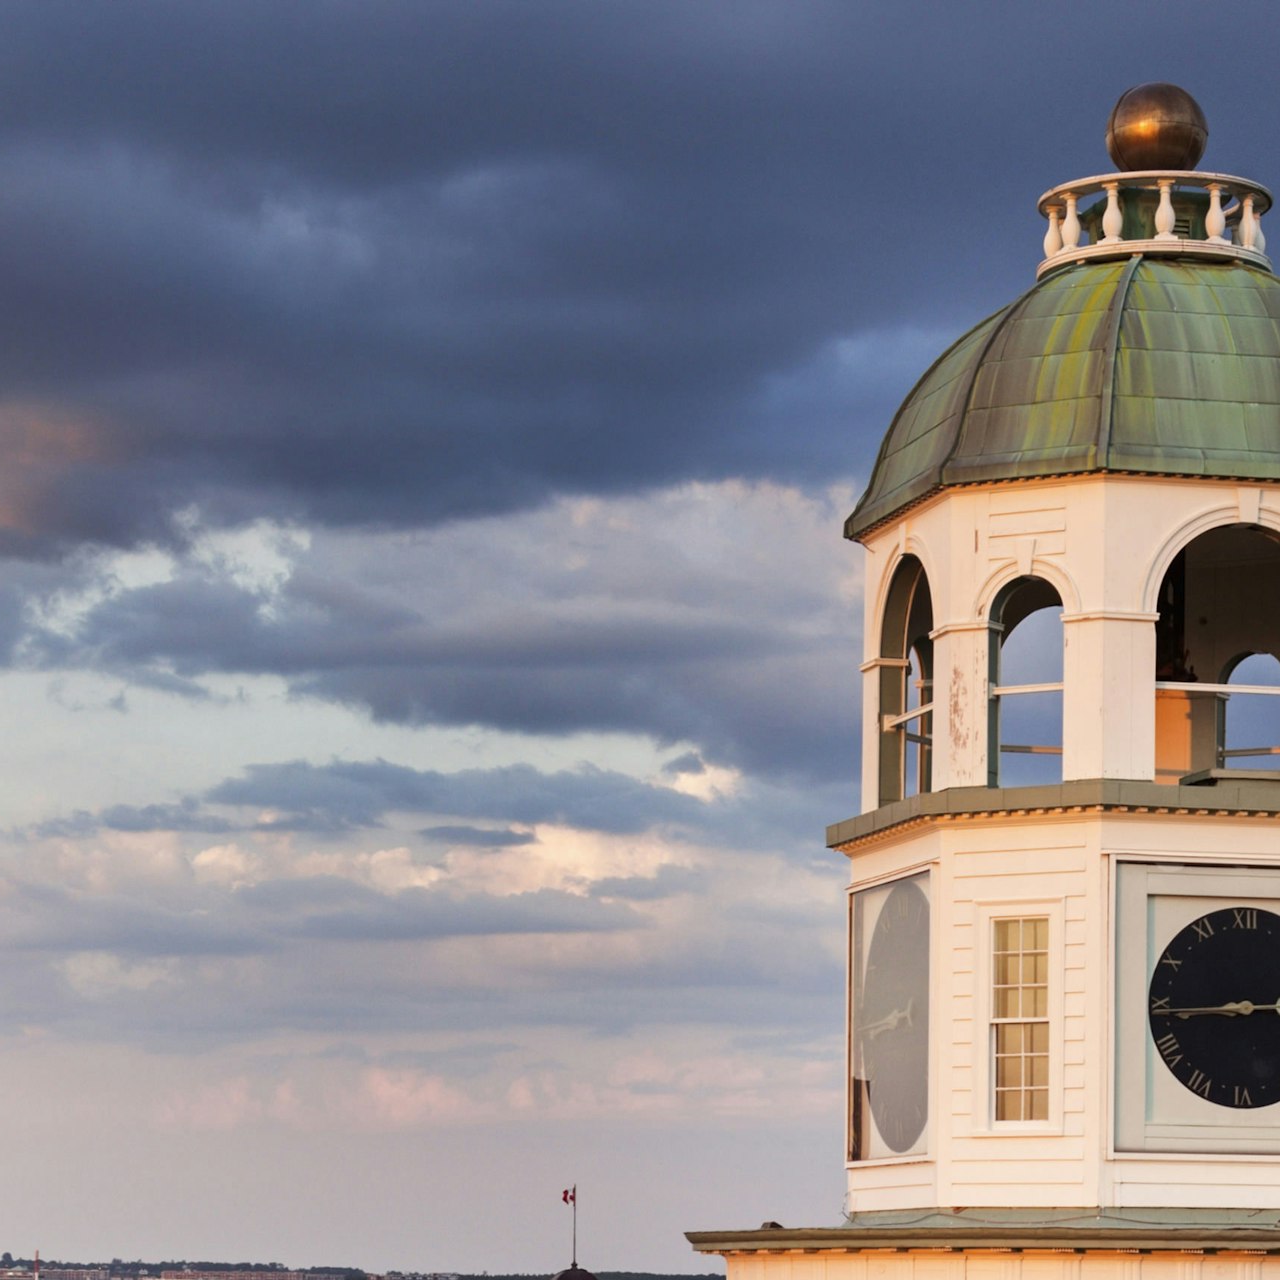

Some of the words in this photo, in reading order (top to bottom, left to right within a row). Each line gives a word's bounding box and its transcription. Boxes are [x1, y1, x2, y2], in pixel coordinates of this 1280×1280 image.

[1191, 918, 1215, 943] XI
[1232, 909, 1258, 930] XII
[1162, 953, 1183, 972] X
[1156, 1031, 1184, 1068] VIII
[1186, 1069, 1212, 1099] VII
[1233, 1085, 1253, 1106] VI
